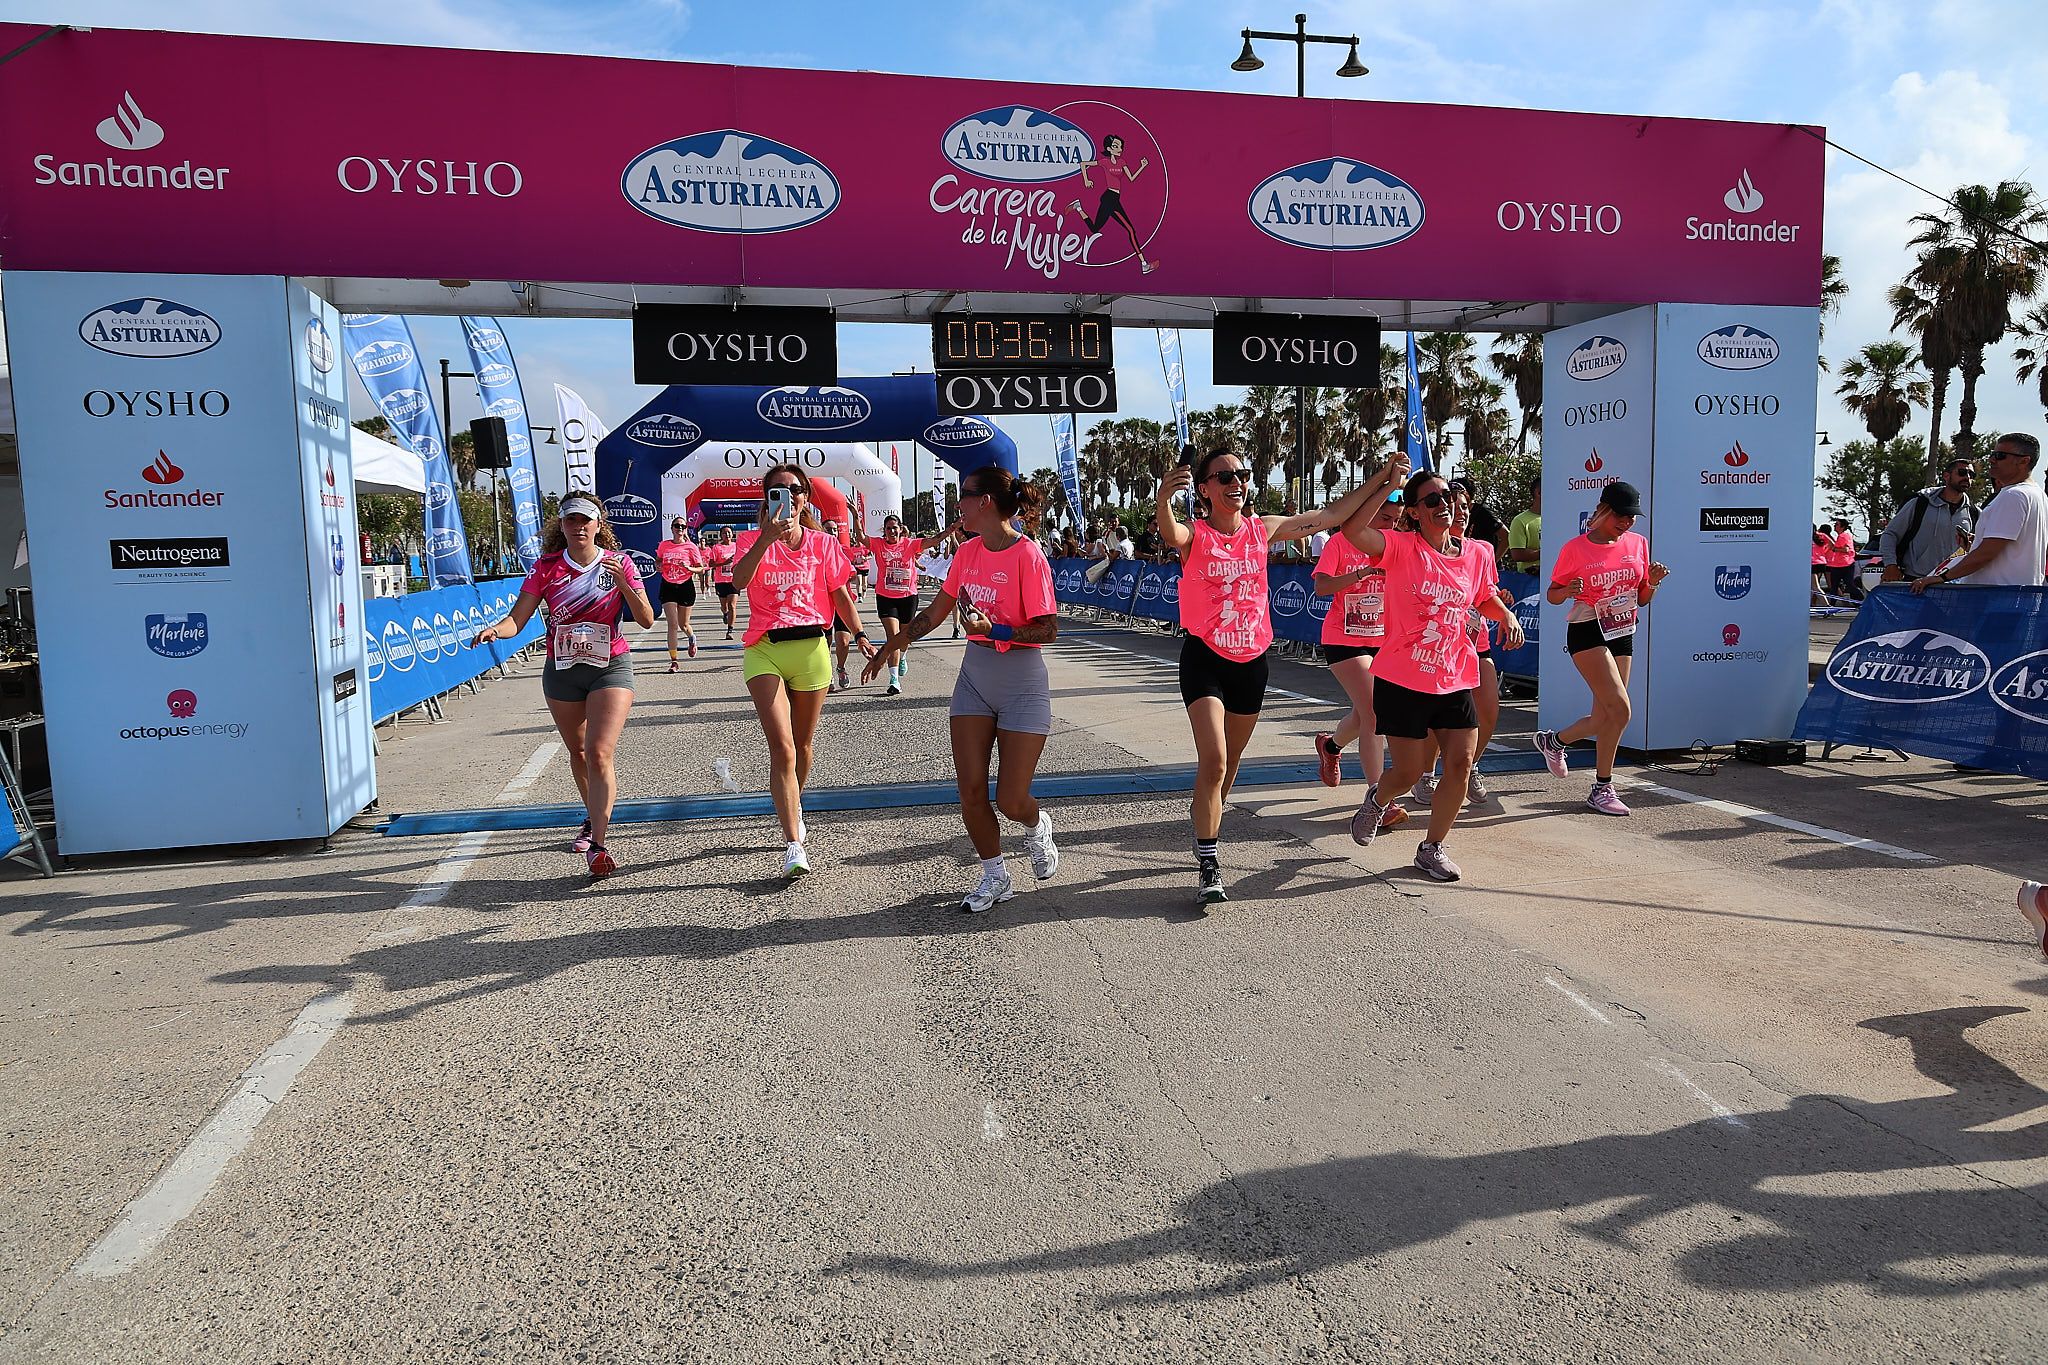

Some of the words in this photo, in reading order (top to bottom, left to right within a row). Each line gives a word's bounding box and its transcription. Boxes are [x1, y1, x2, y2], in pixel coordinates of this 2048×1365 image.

[977, 130, 1027, 142] CENTRAL
[1030, 131, 1080, 143] LECHERA
[955, 132, 1083, 166] ASTURIANA
[34, 154, 230, 191] Santander
[337, 157, 523, 197] OYSHO
[673, 163, 742, 179] CENTRAL
[748, 166, 817, 180] LECHERA
[639, 164, 826, 210] ASTURIANA
[929, 173, 1057, 216] Carrera
[1290, 188, 1346, 200] CENTRAL
[1349, 190, 1407, 203] LECHERA
[1262, 189, 1412, 229] ASTURIANA
[1497, 200, 1623, 236] OYSHO
[1686, 216, 1800, 244] Santander
[962, 217, 986, 244] de
[990, 221, 1008, 247] la
[1004, 215, 1102, 280] Mujer
[90, 319, 213, 343] ASTURIANA
[111, 318, 157, 326] CENTRAL
[161, 318, 206, 327] LECHERA
[668, 332, 807, 364] OYSHO
[946, 321, 1101, 361] 00:36:10
[1703, 341, 1773, 359] ASTURIANA
[1242, 335, 1358, 367] OYSHO
[1570, 356, 1622, 374] ASTURIANA
[945, 375, 1108, 410] OYSHO
[83, 390, 231, 417] OYSHO
[766, 397, 862, 419] ASTURIANA
[1564, 399, 1627, 426] OYSHO
[1694, 395, 1780, 415] OYSHO
[631, 425, 695, 440] ASTURIANA
[930, 429, 990, 440] ASTURIANA
[724, 448, 826, 469] OYSHO
[662, 472, 695, 480] OYSHO
[854, 469, 883, 477] OYSHO
[1701, 471, 1771, 485] Santander
[710, 479, 739, 489] Sports
[104, 490, 225, 508] Santander
[606, 508, 654, 518] STURIANA
[871, 509, 899, 517] OYSHO
[1705, 512, 1764, 529] Neutrogena
[120, 546, 221, 564] Neutrogena
[1208, 559, 1260, 577] CARRERA
[1591, 568, 1636, 587] CARRERA
[1717, 573, 1750, 591] Marlene
[962, 583, 997, 604] ARRERA
[1362, 612, 1379, 621] 016
[1614, 611, 1632, 622] 016
[150, 623, 205, 647] Marlene
[1692, 651, 1734, 664] octopus
[1735, 650, 1769, 663] energy
[1867, 650, 1917, 662] CENTRAL
[1920, 655, 1976, 667] LECHERA
[1834, 651, 1972, 690] ASTURIANA
[120, 726, 190, 741] octopus
[191, 722, 249, 738] energy
